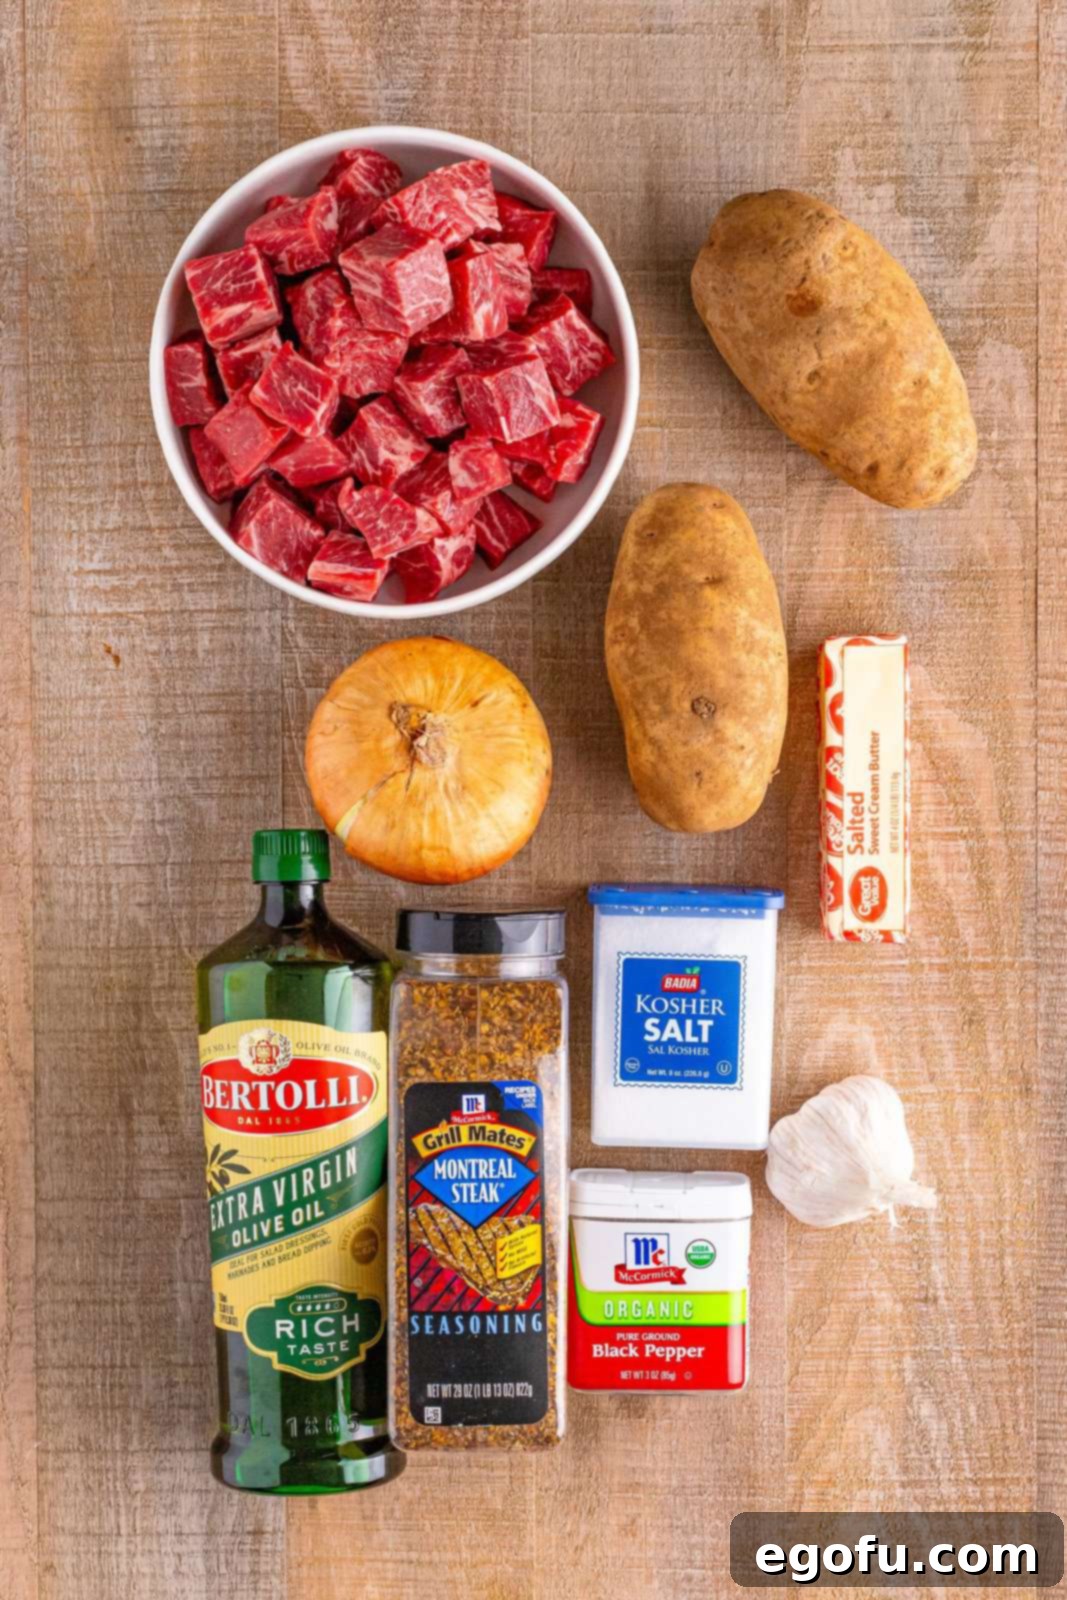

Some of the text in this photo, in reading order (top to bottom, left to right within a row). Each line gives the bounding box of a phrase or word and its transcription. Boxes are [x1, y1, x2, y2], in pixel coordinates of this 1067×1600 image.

[868, 731, 880, 855] Sweet Cream Butter
[846, 792, 865, 856] Salted
[858, 876, 872, 916] Great
[664, 976, 697, 989] BADIA
[636, 994, 726, 1016] KOSHER
[643, 1018, 713, 1043] SALT
[296, 1041, 332, 1052] OLIVE
[334, 1044, 352, 1055] OIL
[648, 1044, 709, 1056] SAL KOSHER
[237, 1116, 260, 1126] DAL
[451, 1113, 494, 1123] McCormick
[423, 1125, 526, 1150] Grill Mates
[434, 1158, 516, 1180] MONTREAL
[210, 1146, 358, 1231] EXTRA VIRGIN
[451, 1182, 500, 1203] STEAK
[231, 1201, 325, 1248] OLIVE OIL
[260, 1244, 283, 1258] SALAD
[262, 1257, 277, 1269] AND
[278, 1248, 302, 1265] BREAD
[618, 1269, 676, 1282] McCormick
[604, 1300, 694, 1320] ORGANIC
[275, 1313, 360, 1339] RICH
[410, 1313, 543, 1335] SEASONING
[616, 1332, 681, 1341] PURE GROUND
[287, 1340, 349, 1356] TASTE
[592, 1343, 705, 1362] Black Pepper
[620, 1370, 632, 1380] NET
[427, 1384, 440, 1398] NET
[441, 1384, 452, 1398] WT
[463, 1383, 473, 1398] OZ
